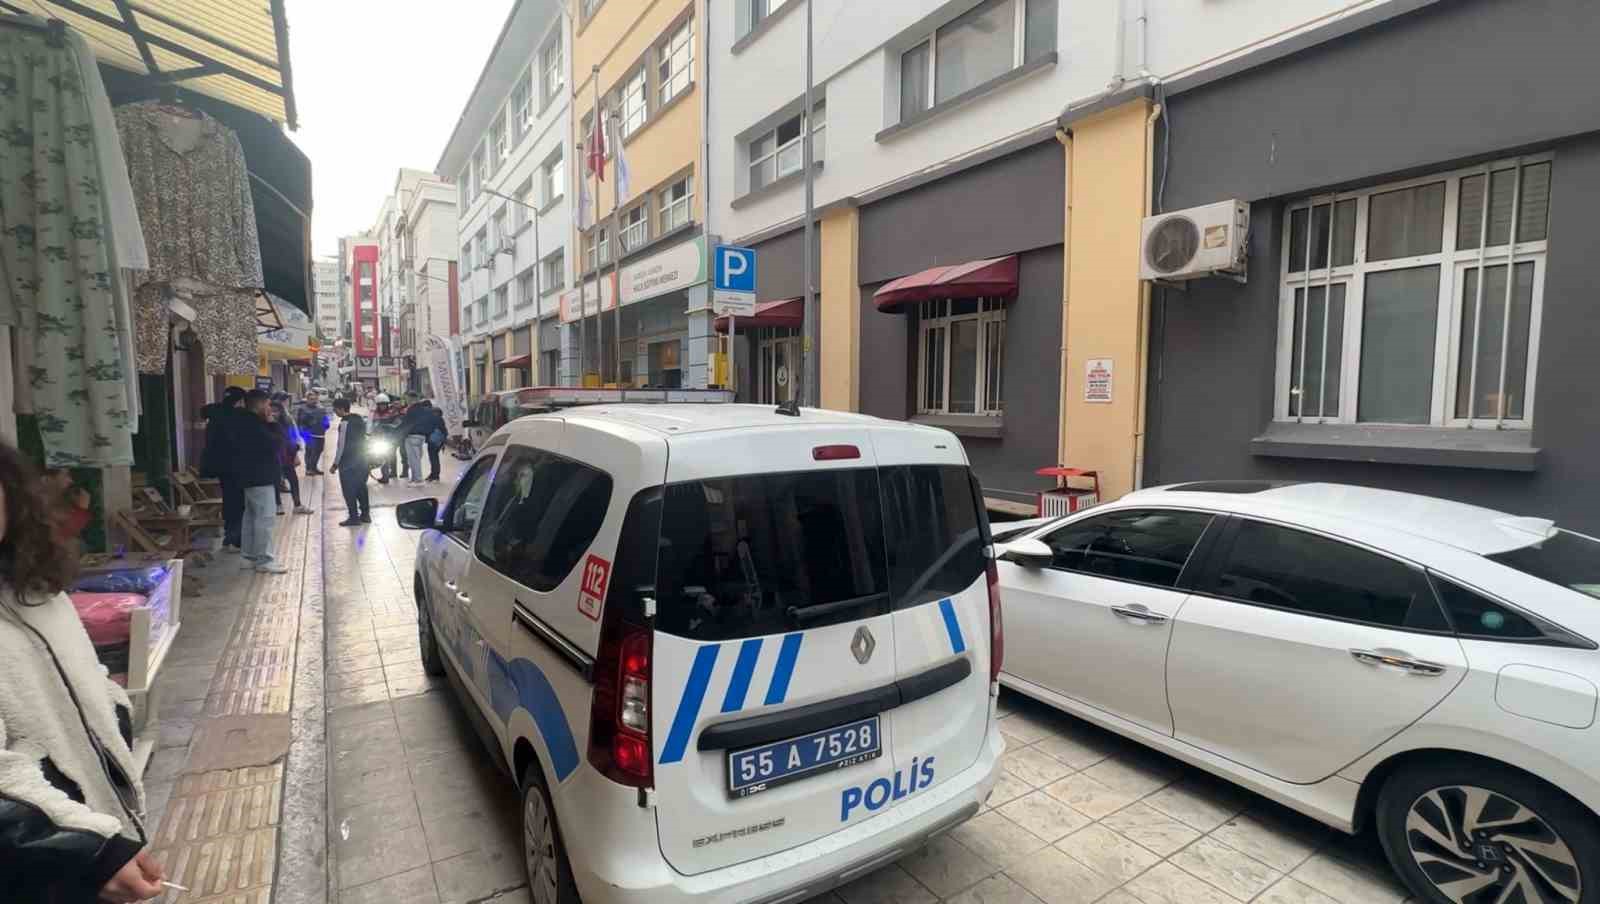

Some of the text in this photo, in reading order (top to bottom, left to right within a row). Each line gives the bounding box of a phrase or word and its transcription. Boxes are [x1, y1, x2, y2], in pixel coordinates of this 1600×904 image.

[724, 250, 748, 287] P
[586, 562, 605, 595] 112
[741, 725, 872, 781] 55 A 7528
[841, 756, 935, 822] POLİS
